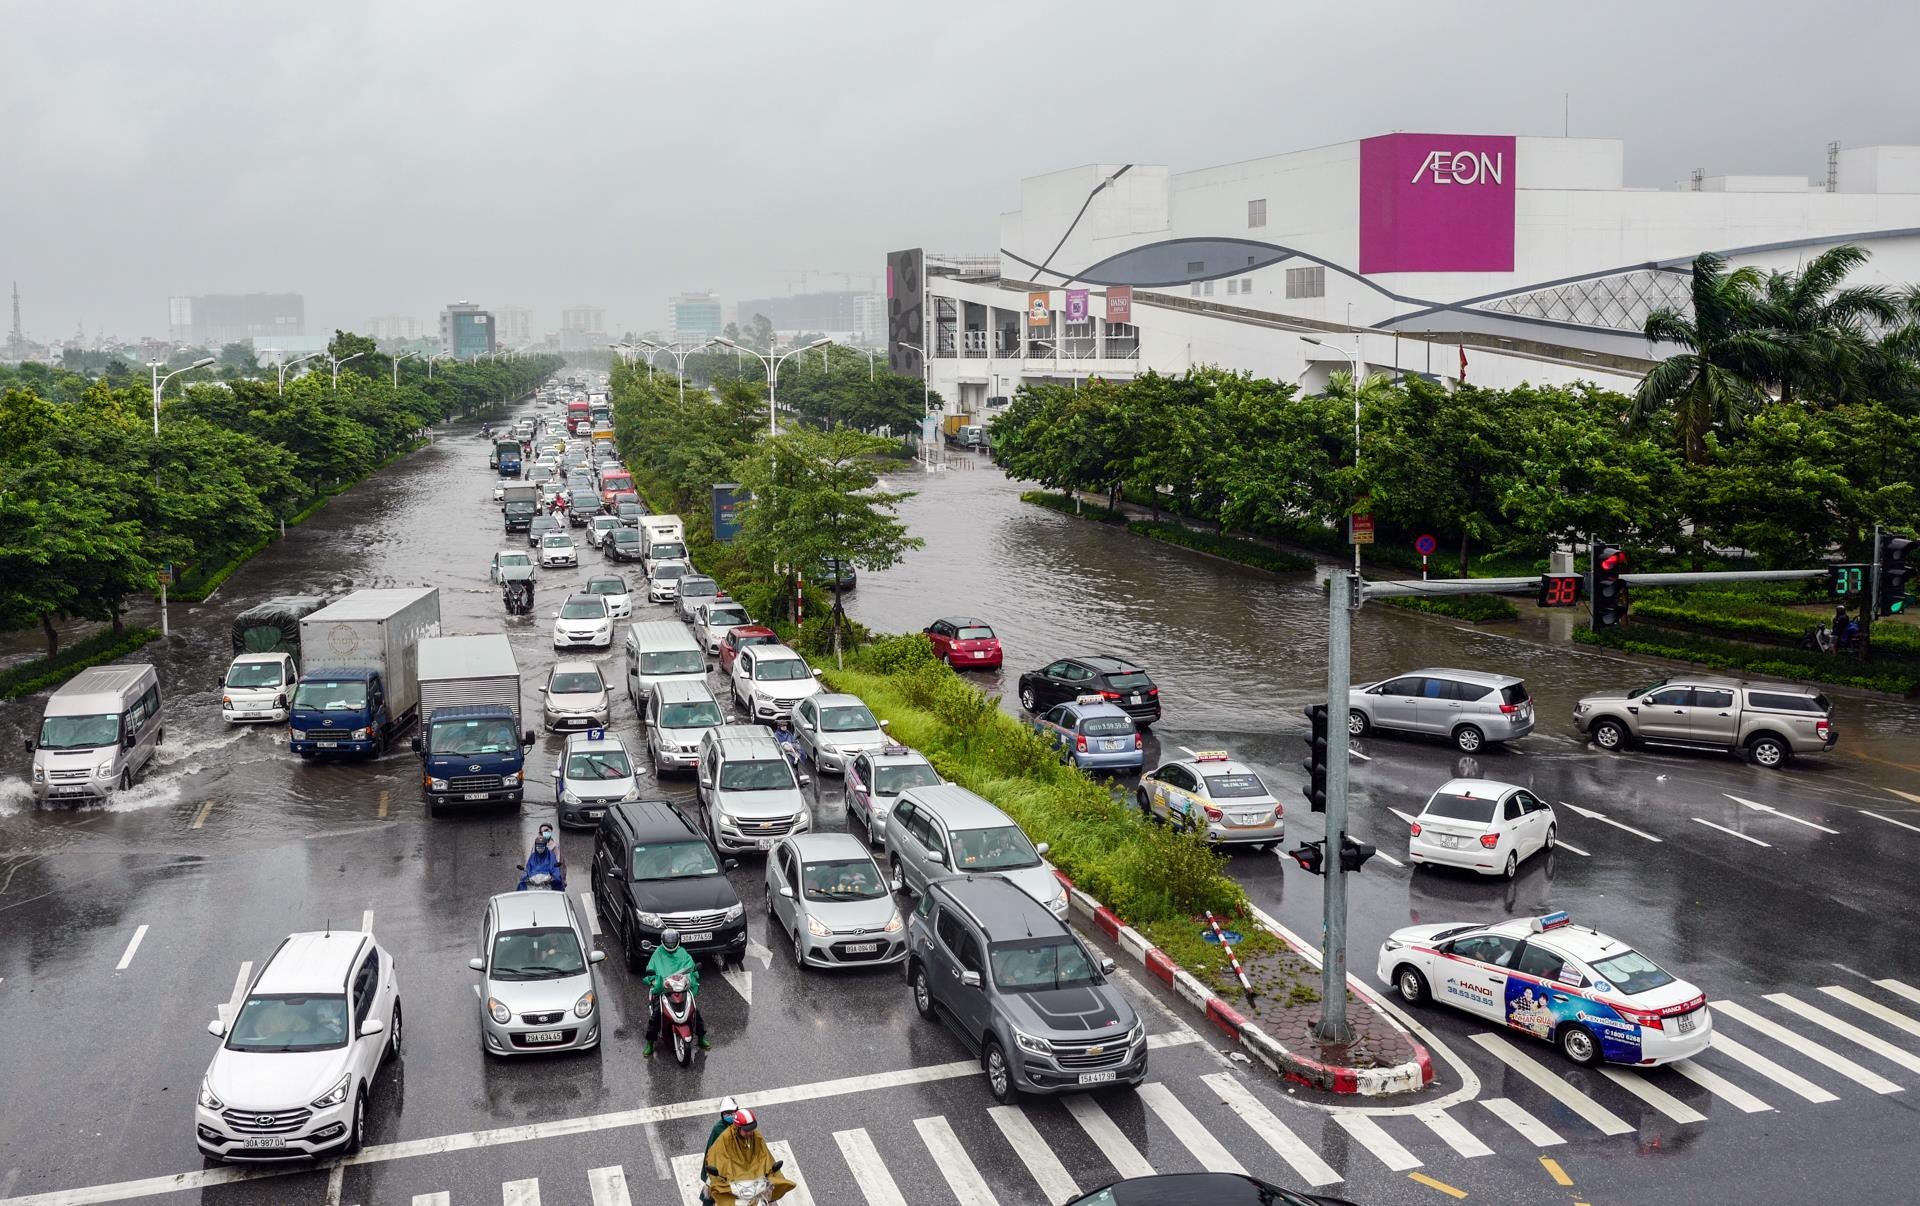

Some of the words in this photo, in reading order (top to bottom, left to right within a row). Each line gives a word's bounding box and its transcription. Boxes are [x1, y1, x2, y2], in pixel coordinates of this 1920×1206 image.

[1111, 298, 1127, 307] DAISO
[1837, 568, 1861, 593] 37
[1547, 578, 1575, 604] 38
[1460, 981, 1493, 997] HANOI
